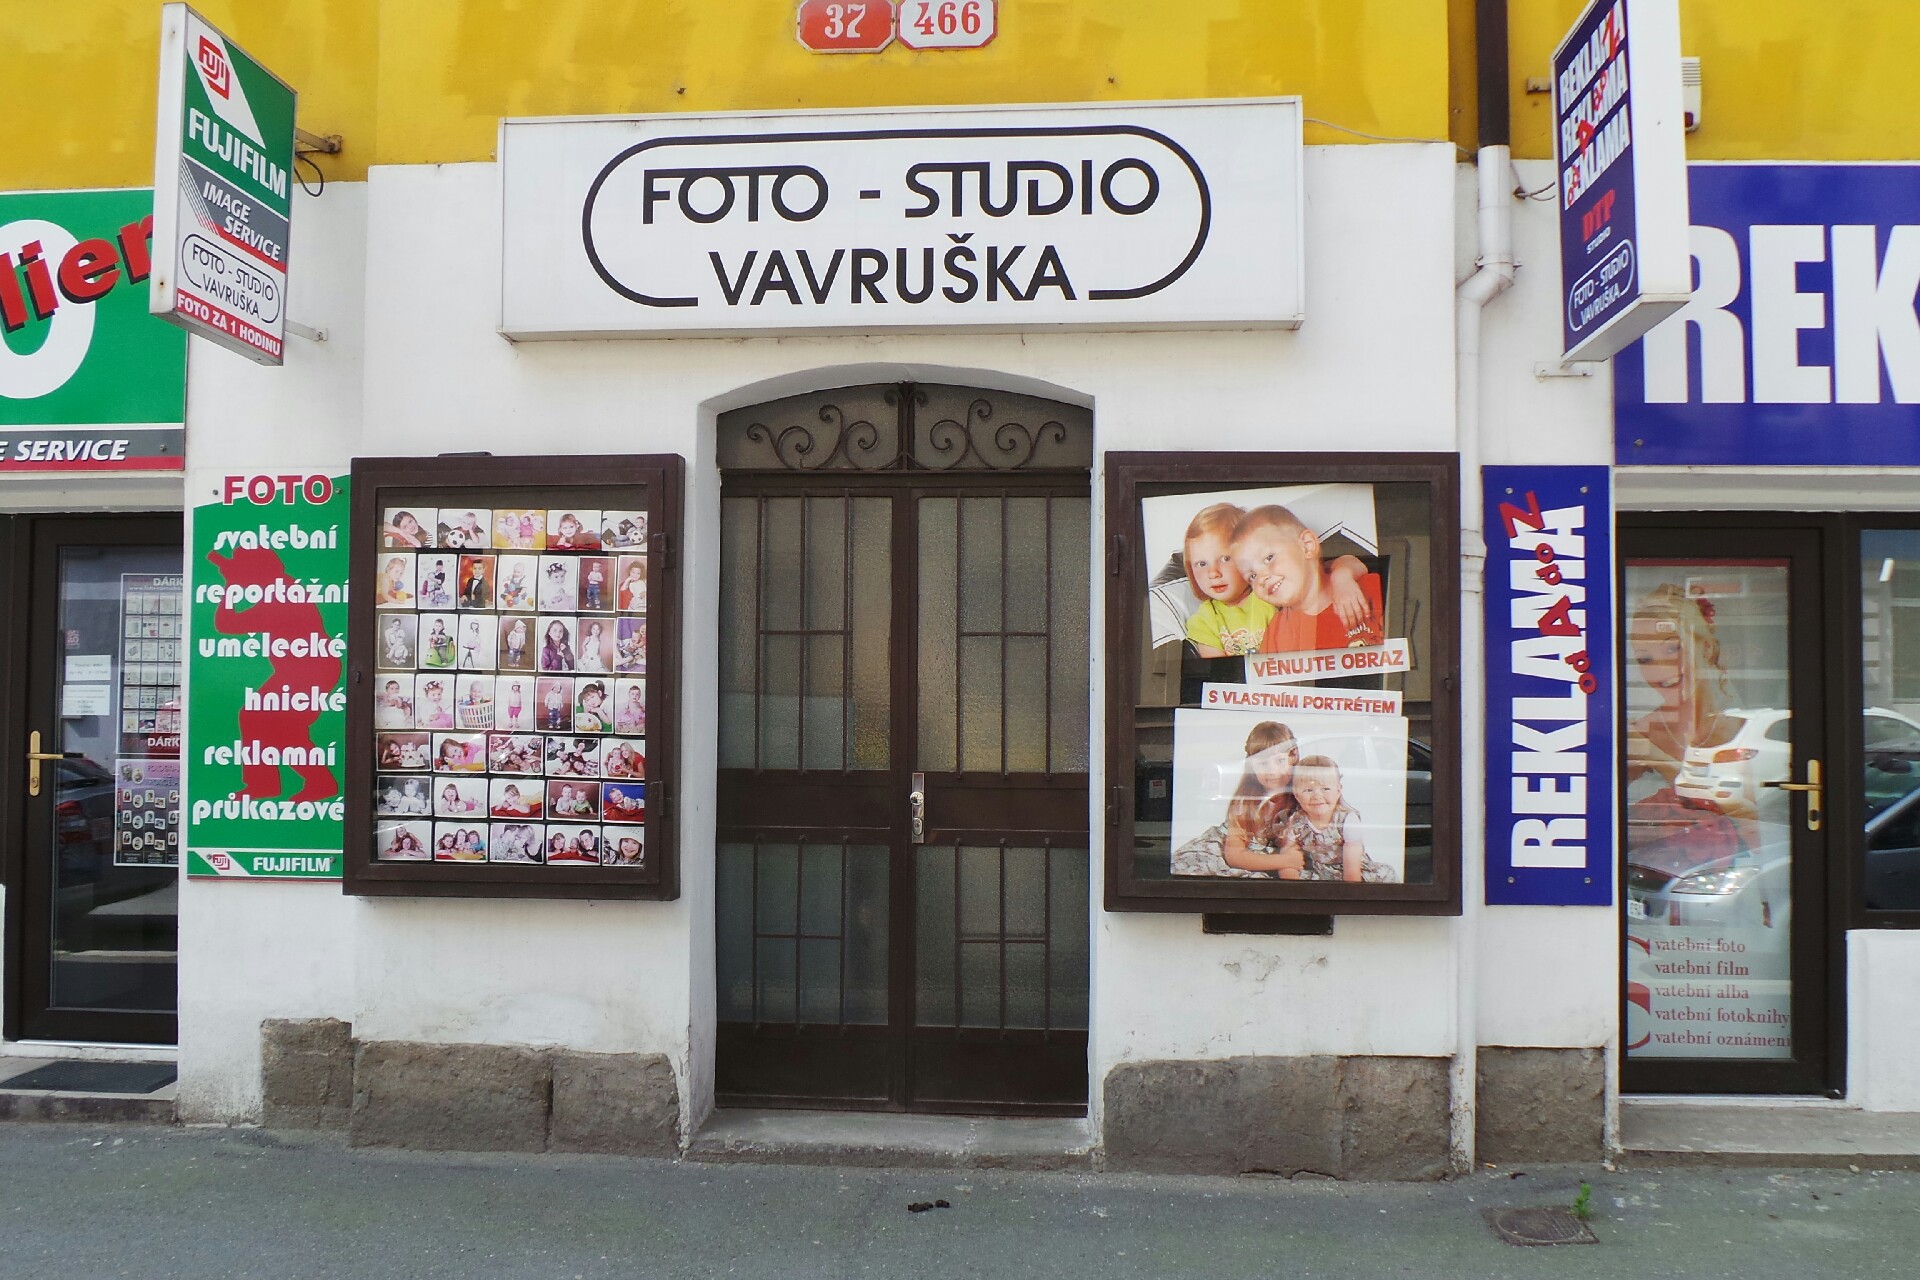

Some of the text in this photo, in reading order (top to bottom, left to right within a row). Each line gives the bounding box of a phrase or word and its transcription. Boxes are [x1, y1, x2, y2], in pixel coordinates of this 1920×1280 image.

[824, 4, 866, 38] 37
[913, 1, 981, 36] 466
[189, 107, 287, 199] FUJIFILM
[202, 181, 251, 223] IMAGE
[643, 165, 829, 225] FOTO
[905, 158, 1160, 218] STUDIO
[224, 215, 281, 261] SERVICE
[192, 243, 225, 275] FOTO
[236, 268, 273, 301] STUDIO
[709, 233, 1077, 306] VAVRUŠKA
[1574, 279, 1594, 309] FOTO
[1600, 249, 1629, 287] STUDIO
[203, 273, 259, 319] VAVRUŠKA
[1580, 283, 1621, 326] VAVRUŠKA
[177, 293, 281, 355] FOTO ZA 1 HODINU
[14, 439, 129, 461] SERVICE
[223, 474, 333, 506] FOTO
[213, 524, 338, 550] svatební
[196, 578, 349, 609] reportážní
[199, 632, 346, 658] umělecké
[1253, 650, 1404, 678] VĚNUJTE OBRAZ
[244, 684, 346, 712] hnické
[1209, 690, 1396, 713] S VLASTNÍM PORTRÉTEM
[1509, 505, 1587, 869] REKLAMA
[204, 740, 336, 766] reklamní
[192, 792, 344, 825] průkazové
[253, 857, 331, 872] FUJIFILM
[1717, 938, 1745, 952] foto
[1717, 961, 1749, 976] film
[1717, 985, 1749, 999] alba
[1717, 1008, 1791, 1028] fotoknihy
